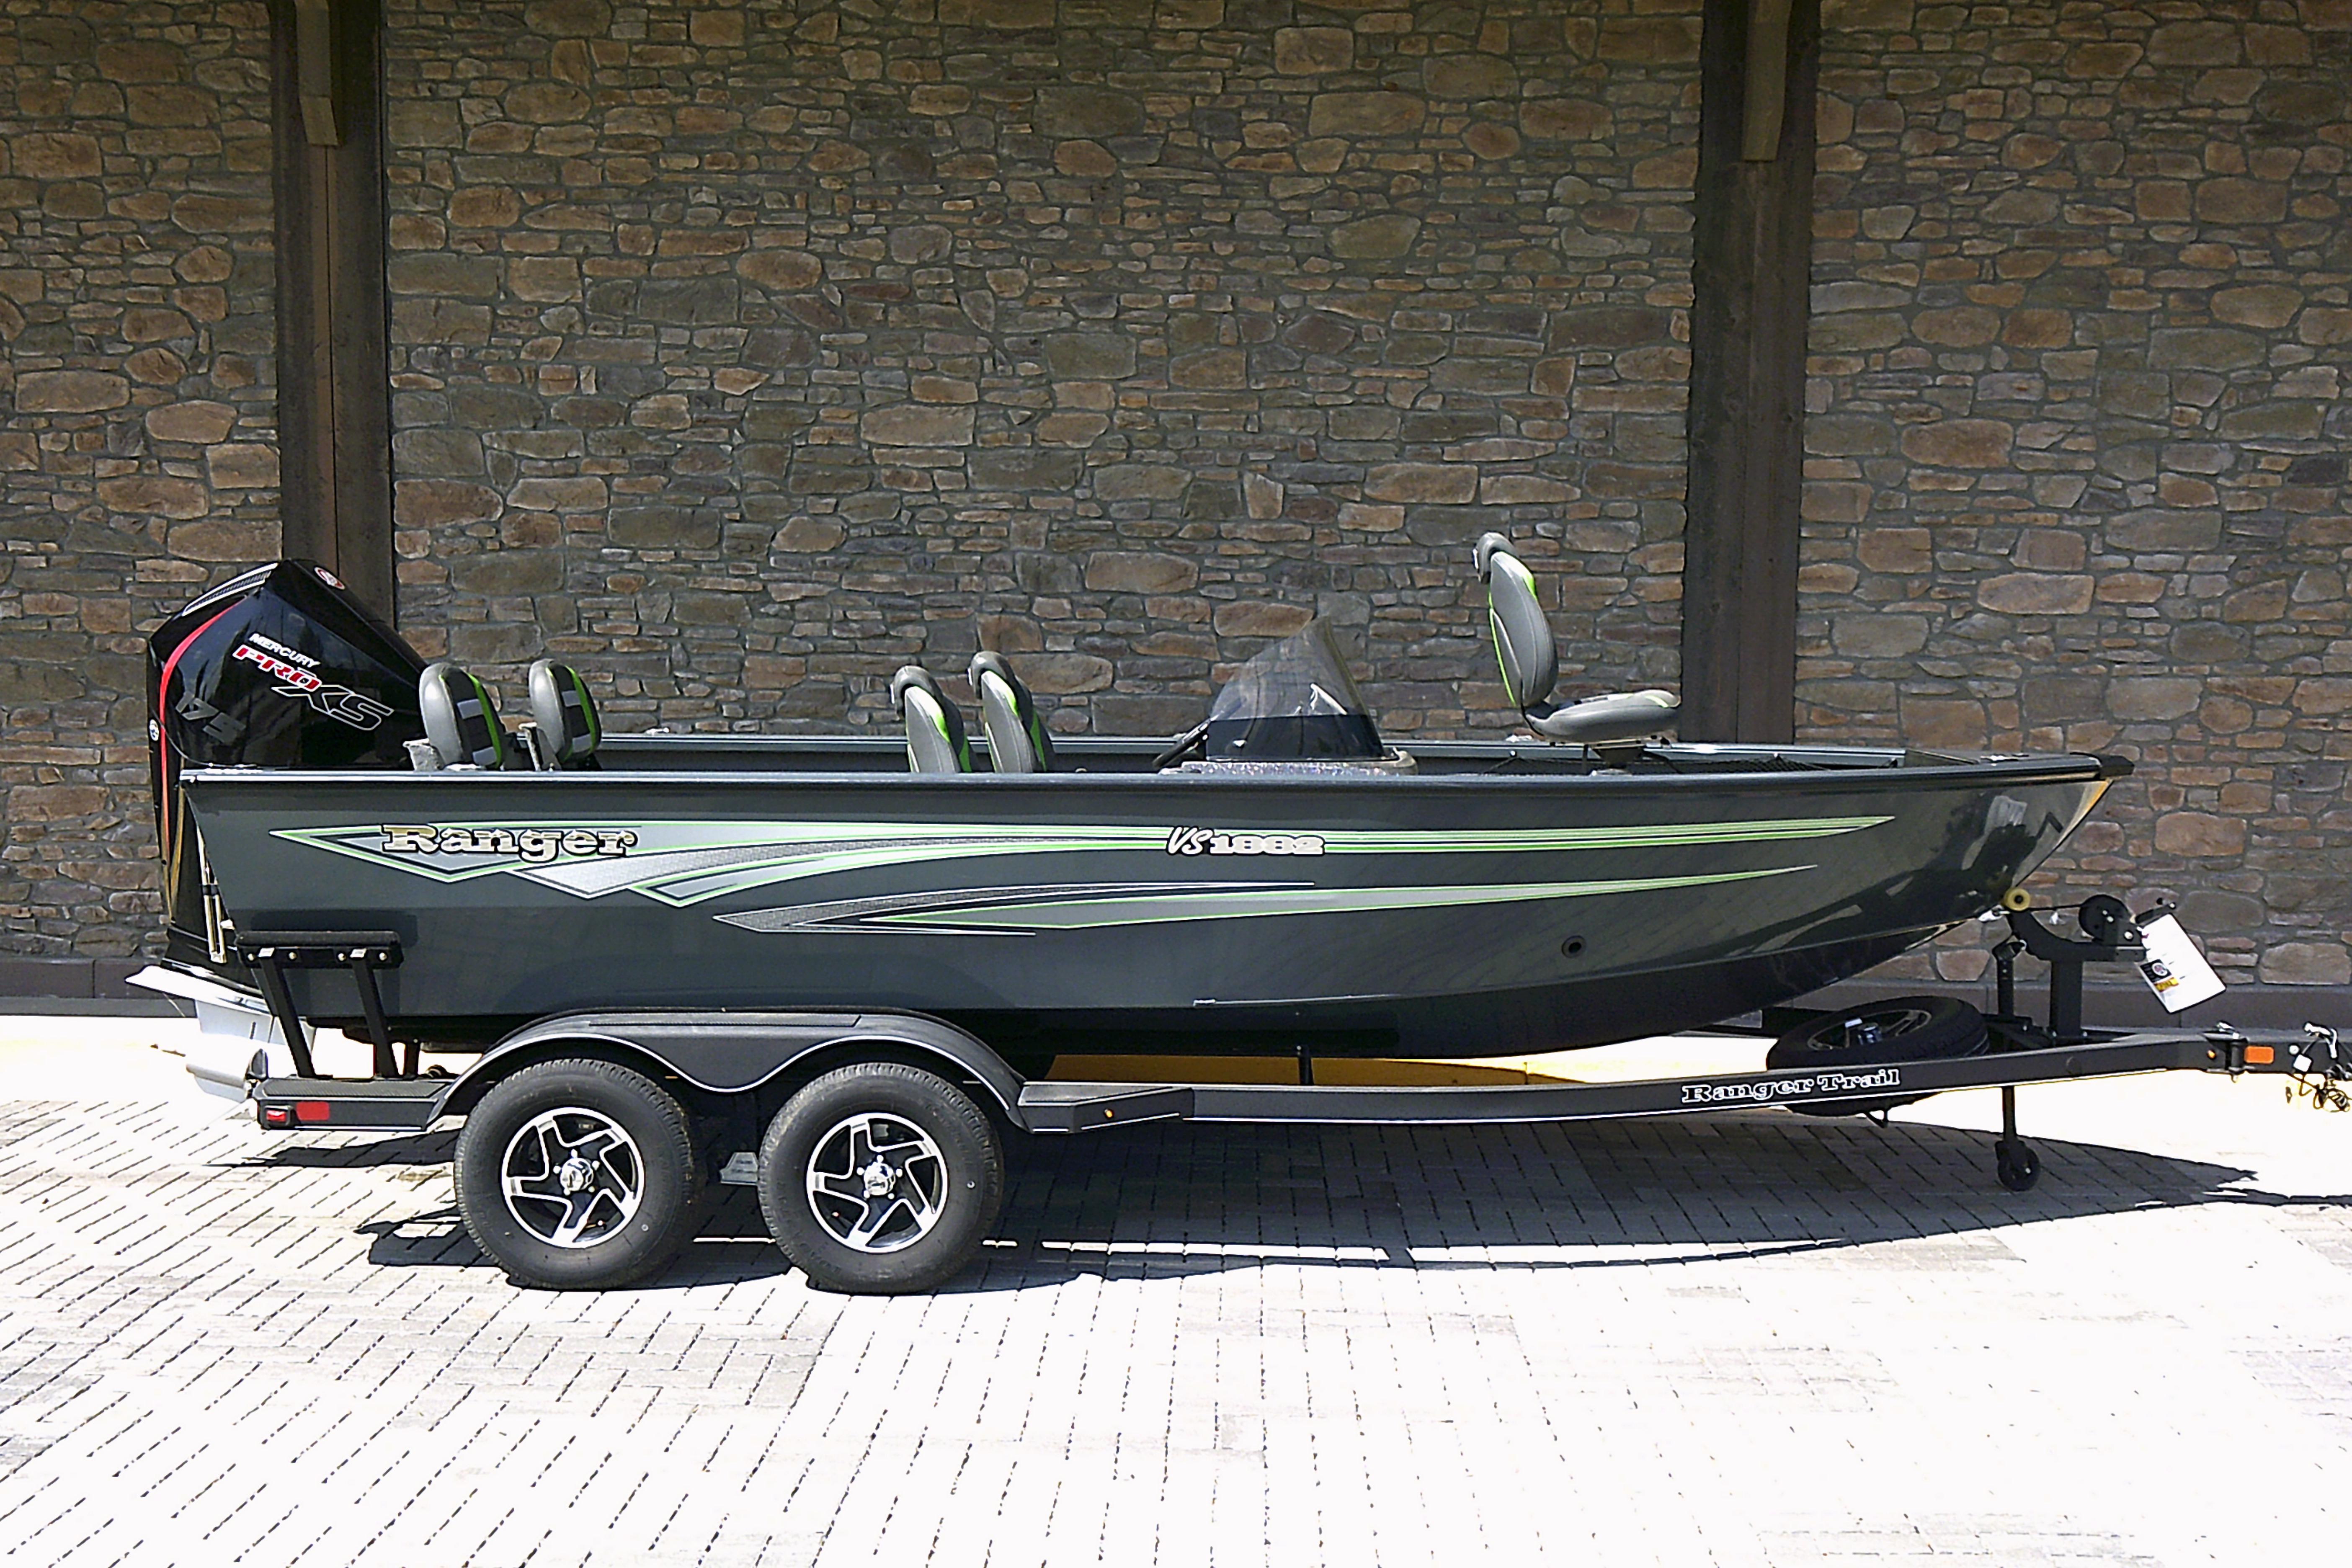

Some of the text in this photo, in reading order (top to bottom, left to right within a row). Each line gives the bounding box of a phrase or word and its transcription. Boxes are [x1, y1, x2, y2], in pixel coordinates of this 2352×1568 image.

[232, 644, 322, 692] PRO
[249, 633, 322, 668] MERCURY
[271, 684, 395, 731] XS
[381, 824, 638, 862] Ranger
[1168, 826, 1325, 855] VS 1882
[1681, 1069, 1900, 1103] Ranger Trail
